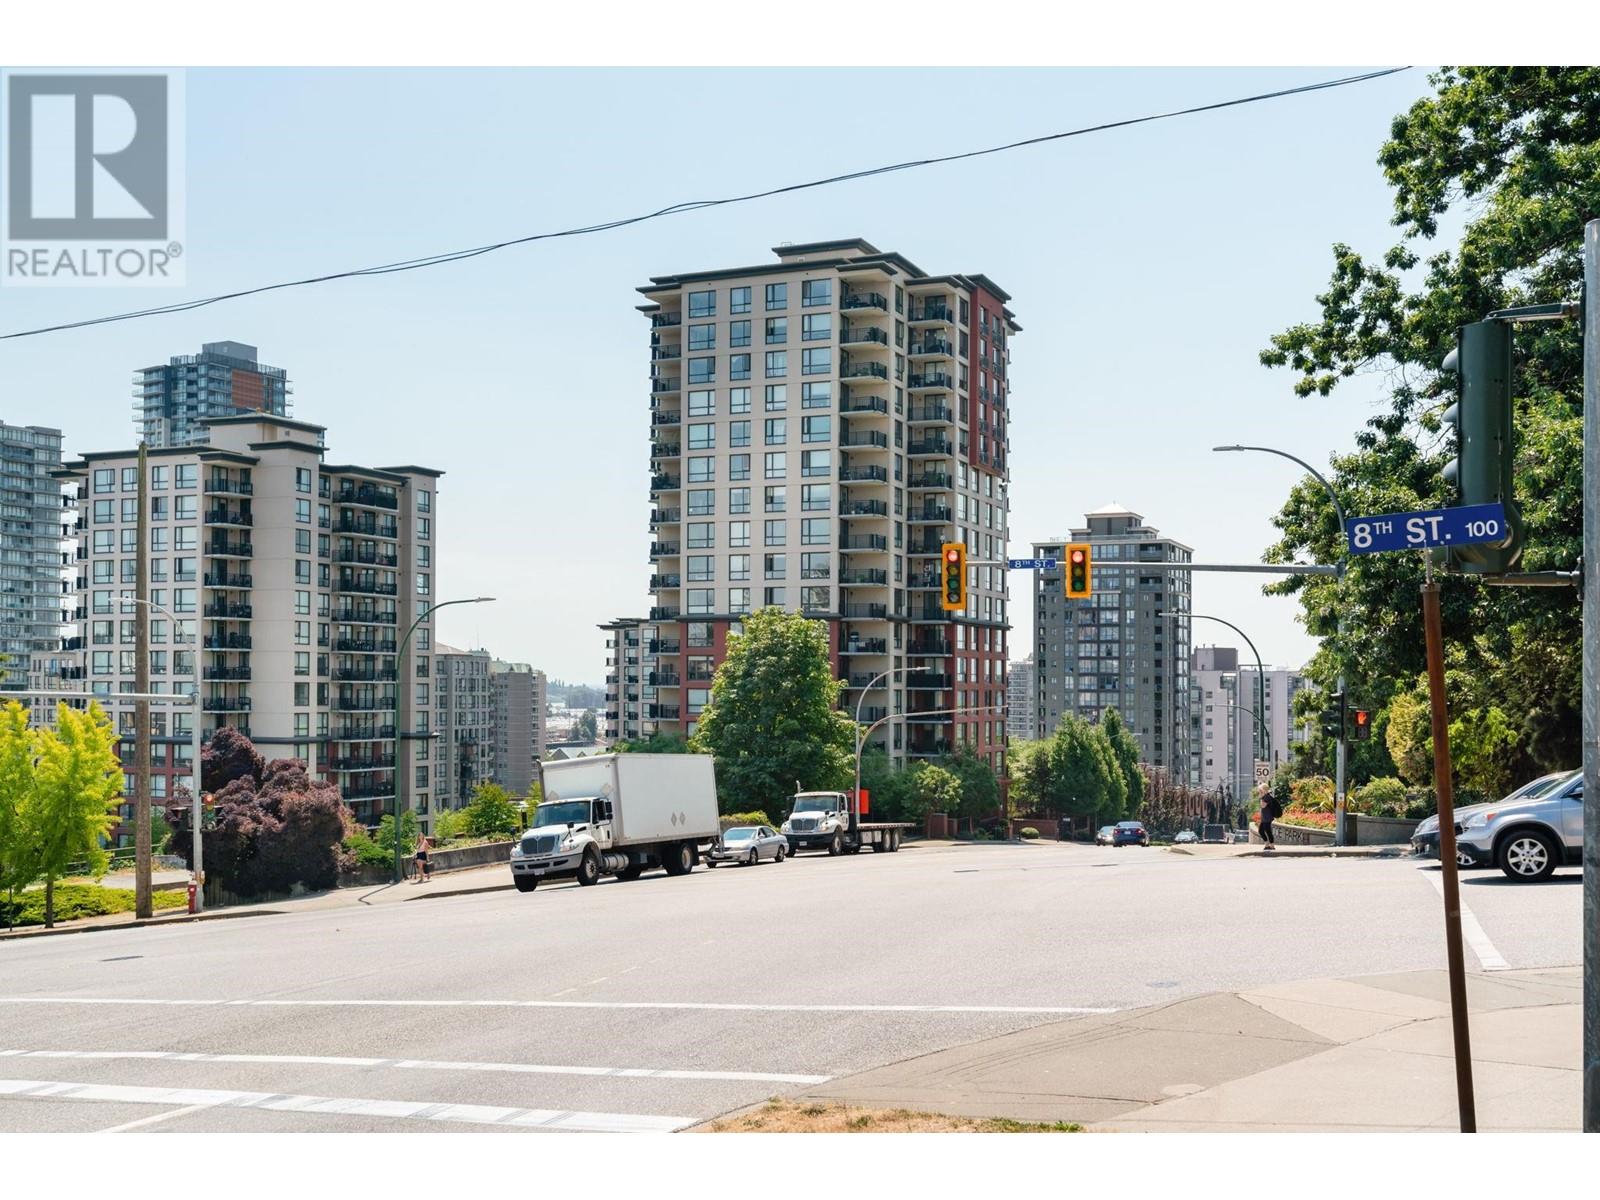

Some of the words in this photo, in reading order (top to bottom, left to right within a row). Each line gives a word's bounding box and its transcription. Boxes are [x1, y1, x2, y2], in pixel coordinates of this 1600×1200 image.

[1353, 521, 1393, 548] 8TH
[1406, 515, 1452, 544] ST.
[1464, 520, 1499, 538] 100
[1256, 768, 1269, 777] 50
